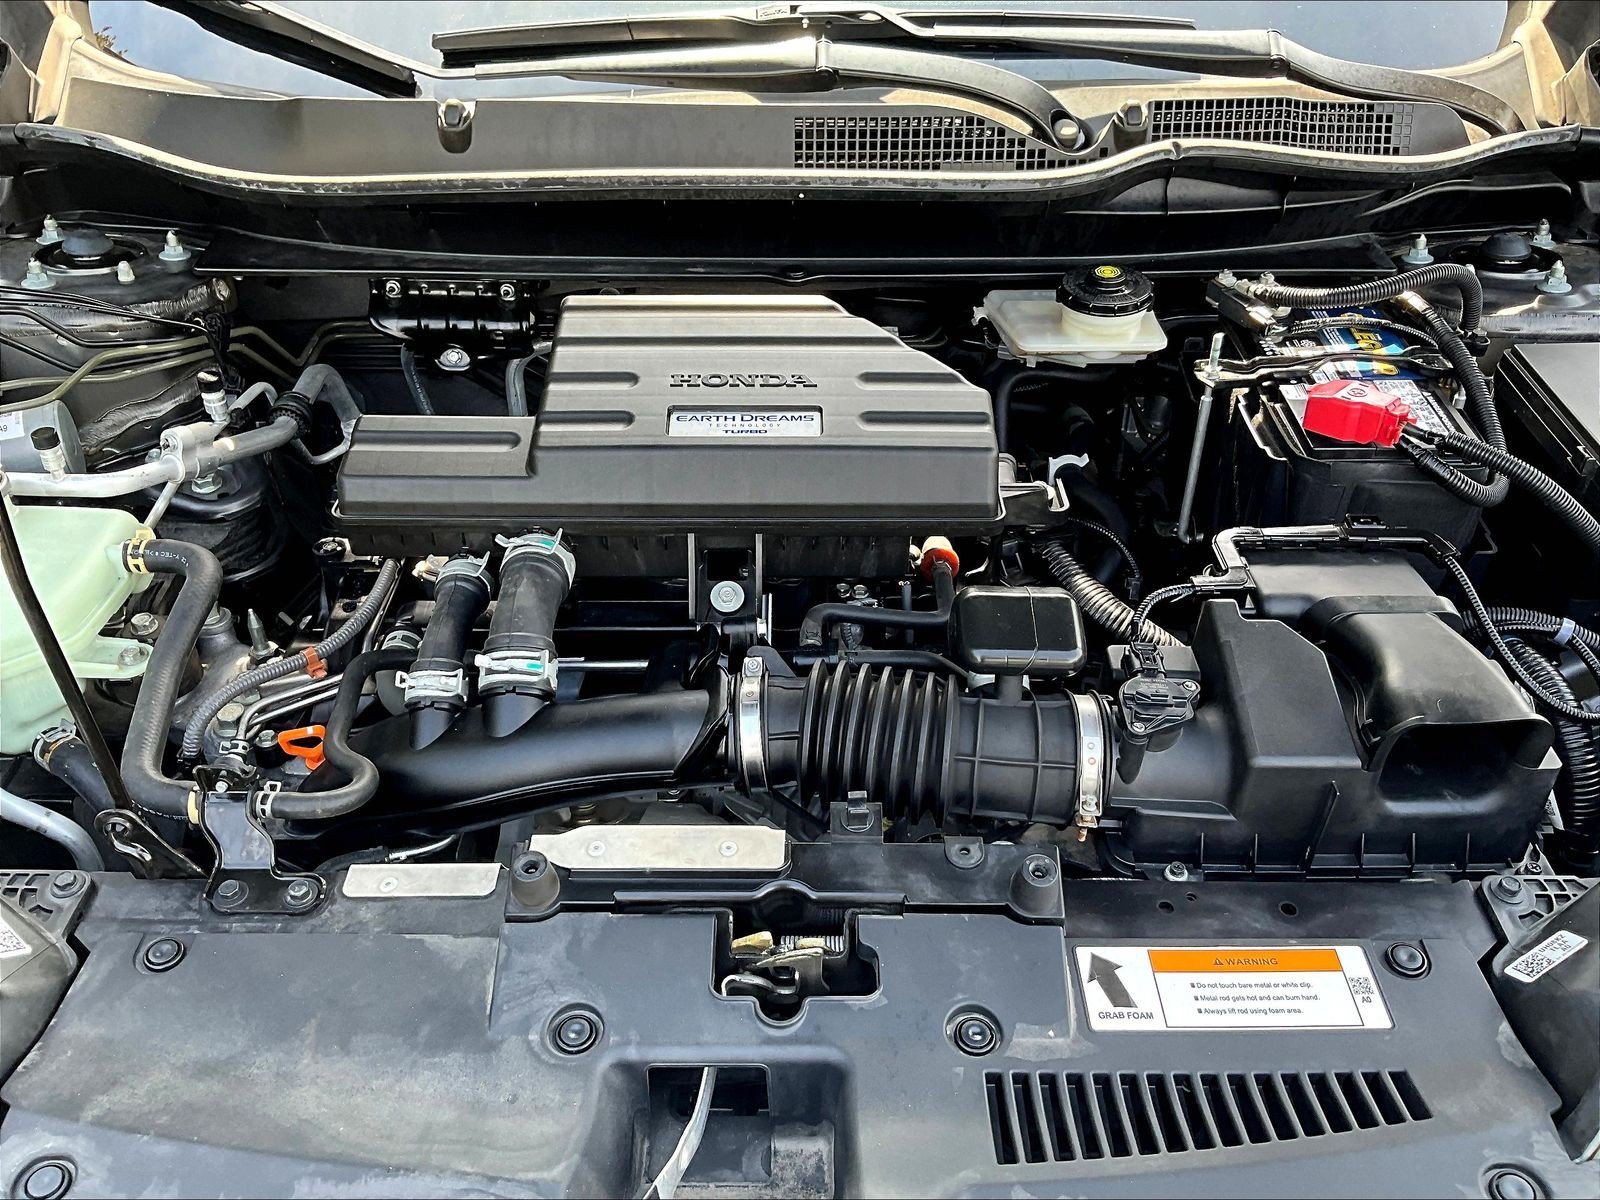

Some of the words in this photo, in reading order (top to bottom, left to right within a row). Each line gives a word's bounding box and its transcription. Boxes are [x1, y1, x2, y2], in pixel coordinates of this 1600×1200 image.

[669, 373, 818, 388] HONDA
[740, 413, 815, 422] DREAMS
[1225, 957, 1279, 966] WARNING
[1231, 995, 1245, 1003] gets
[1098, 1011, 1125, 1020] GRAB
[1126, 1011, 1154, 1020] FOAM
